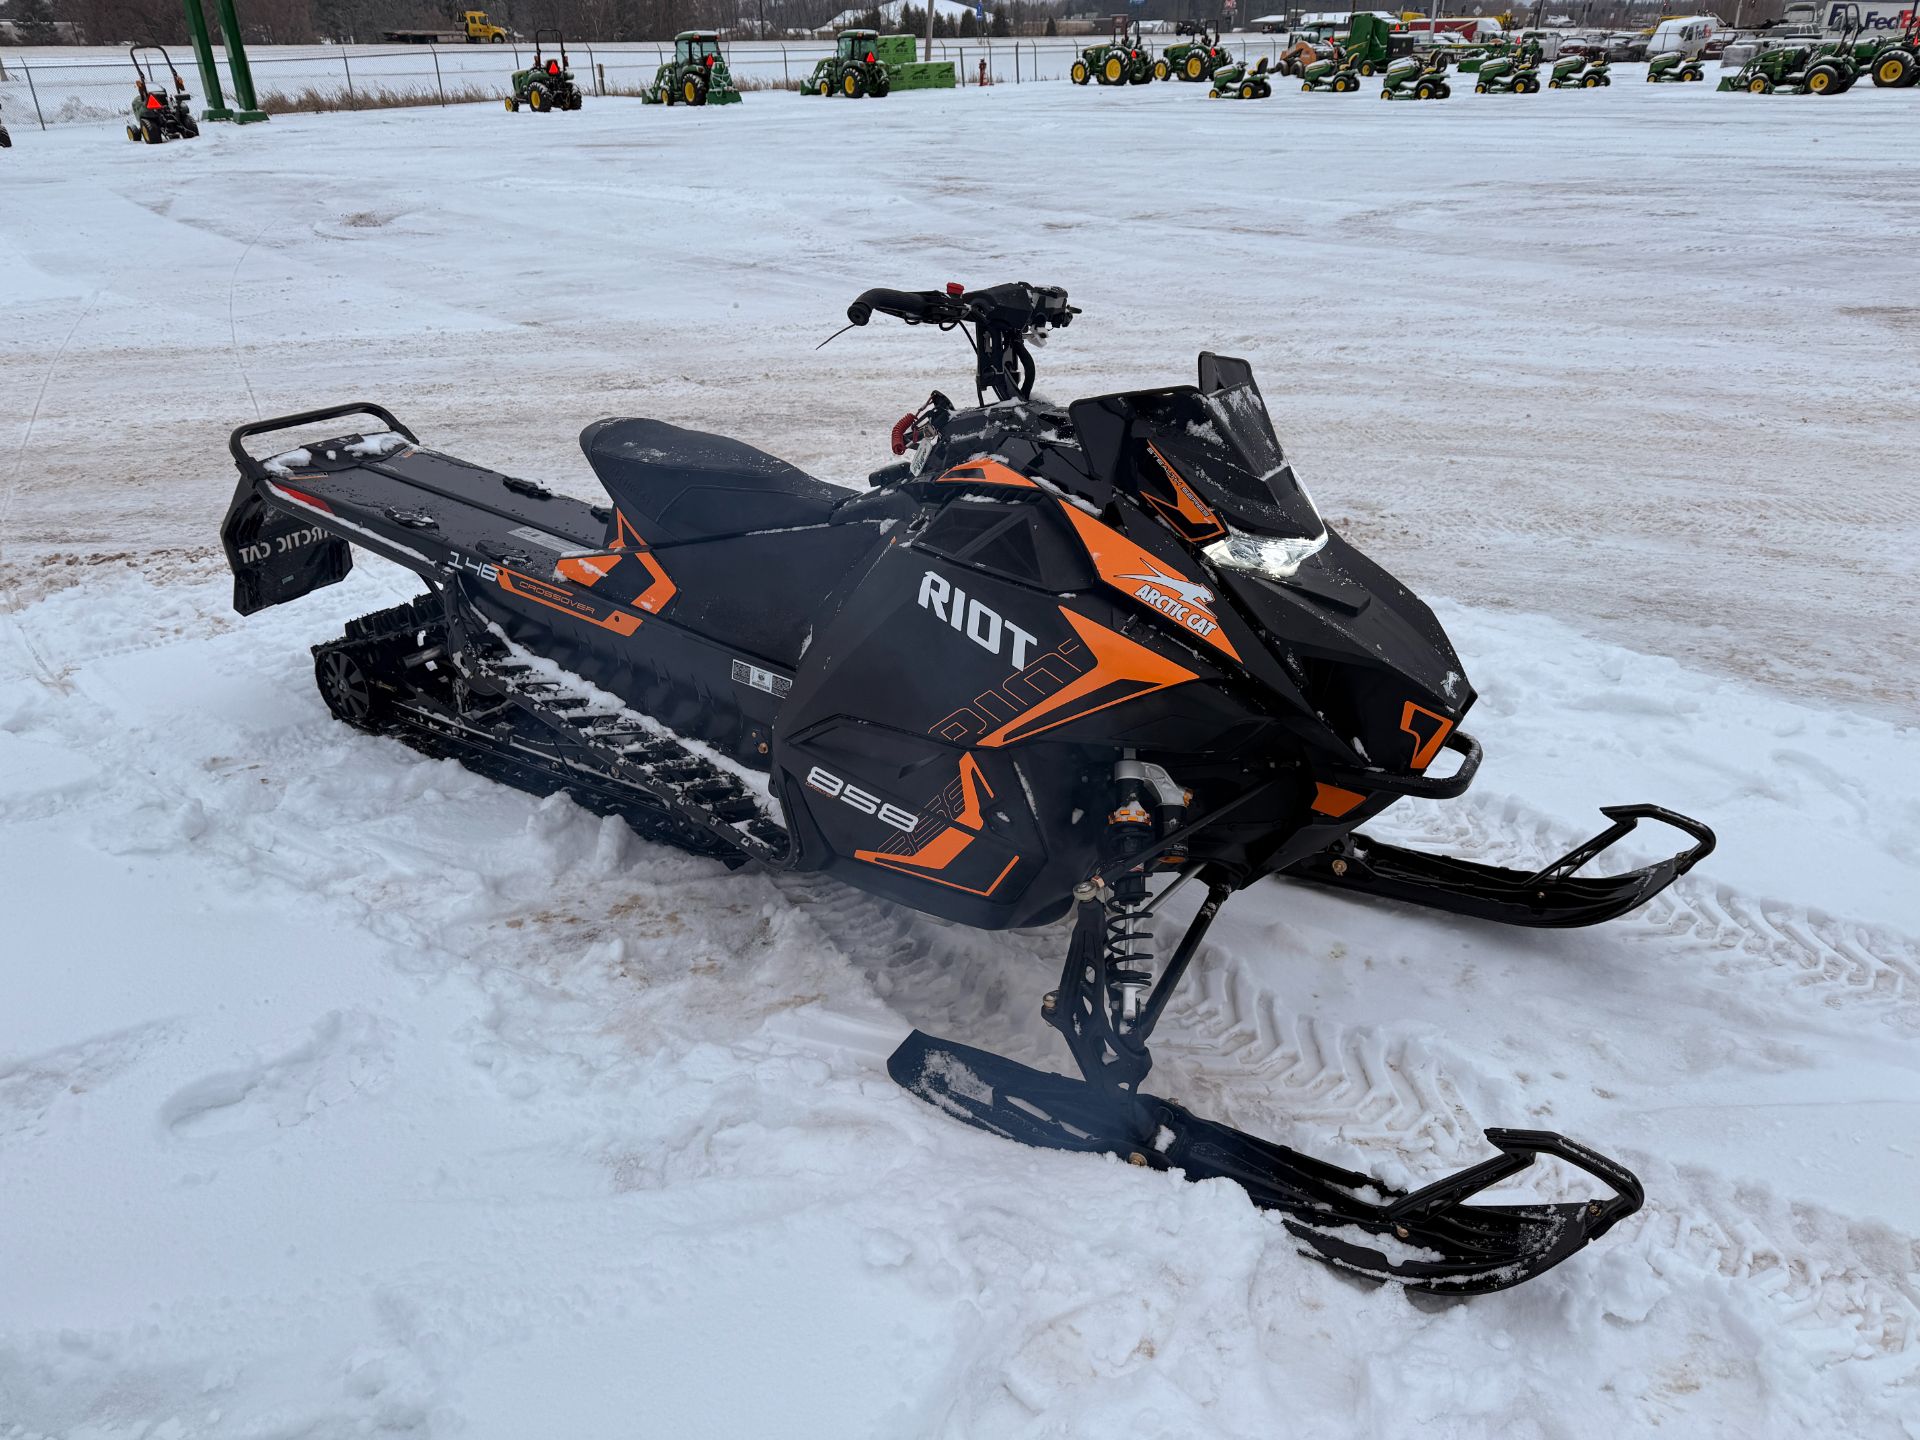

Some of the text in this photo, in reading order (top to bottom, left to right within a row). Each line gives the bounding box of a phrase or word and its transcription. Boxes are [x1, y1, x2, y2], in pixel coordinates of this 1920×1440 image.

[448, 551, 499, 582] 146
[519, 581, 596, 614] CROSSOVER
[917, 570, 1038, 672] RIOT
[1134, 583, 1219, 637] ARCTIC CAT
[807, 766, 919, 833] 858
